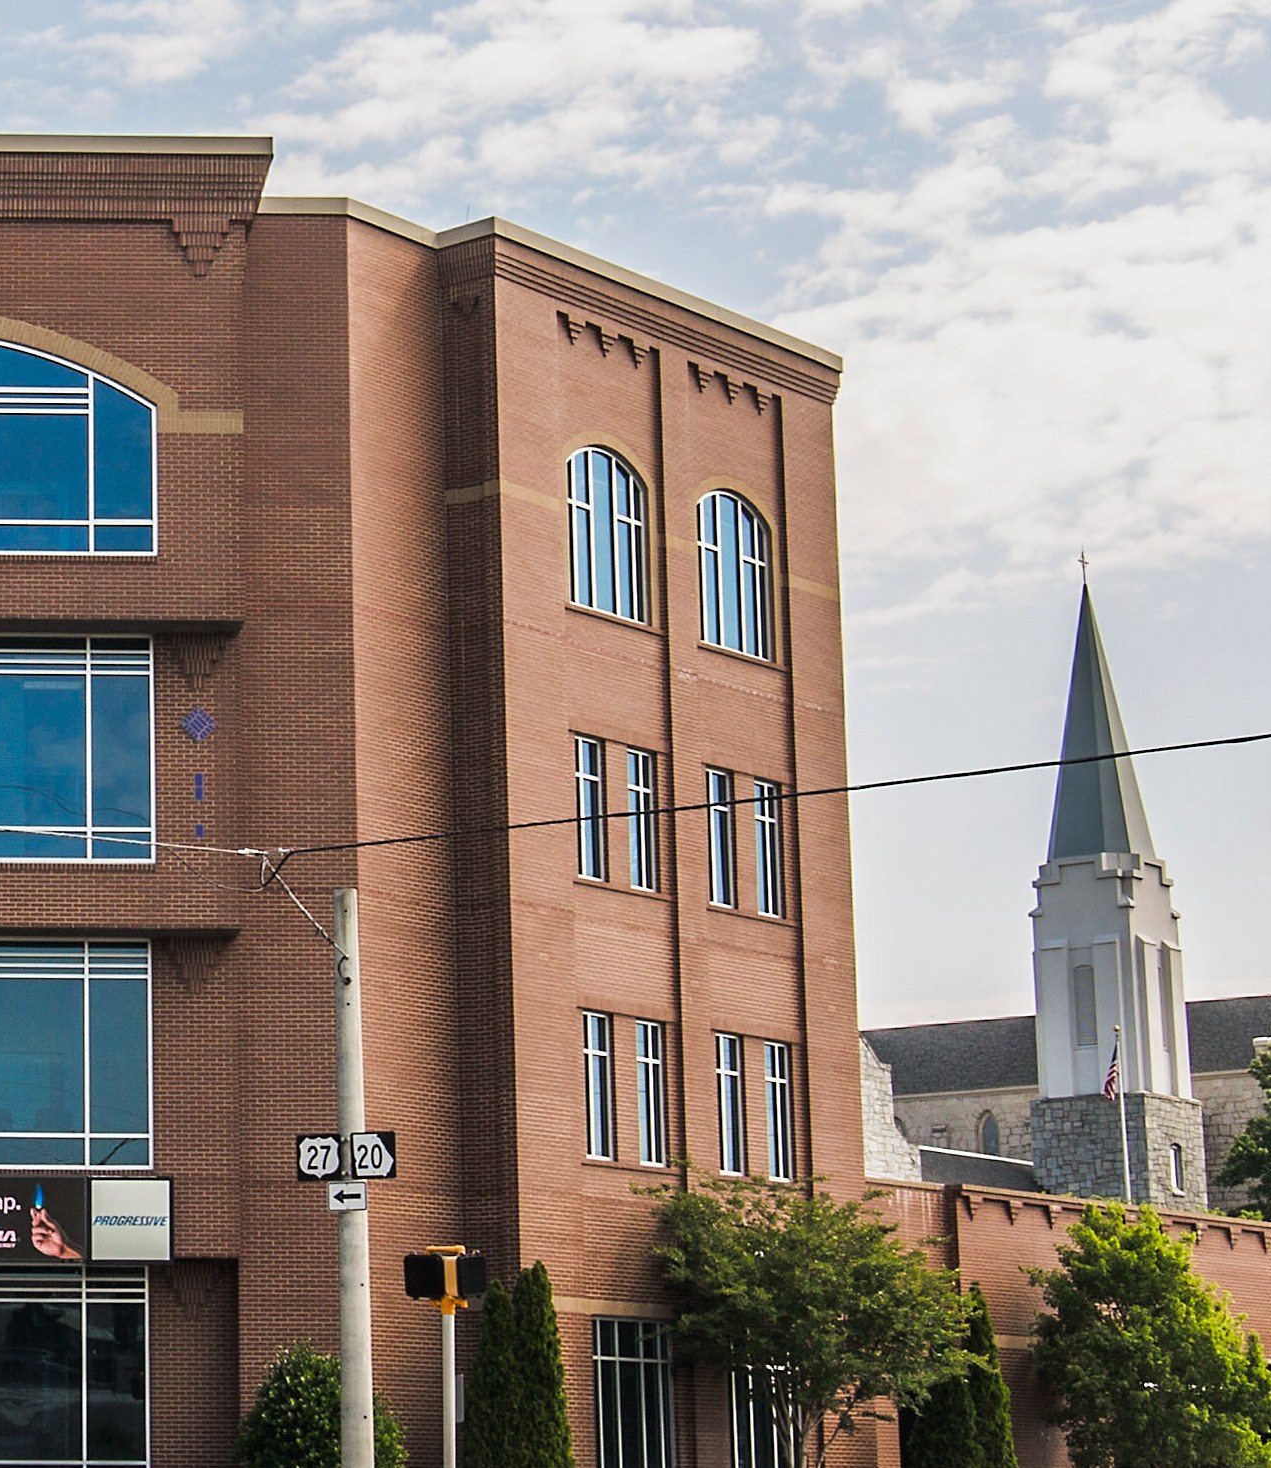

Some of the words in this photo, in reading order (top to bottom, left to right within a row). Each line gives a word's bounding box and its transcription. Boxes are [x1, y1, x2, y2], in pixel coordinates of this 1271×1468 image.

[307, 1145, 331, 1170] 27
[358, 1144, 382, 1169] 20
[93, 1215, 168, 1228] PROGRESSIVE
